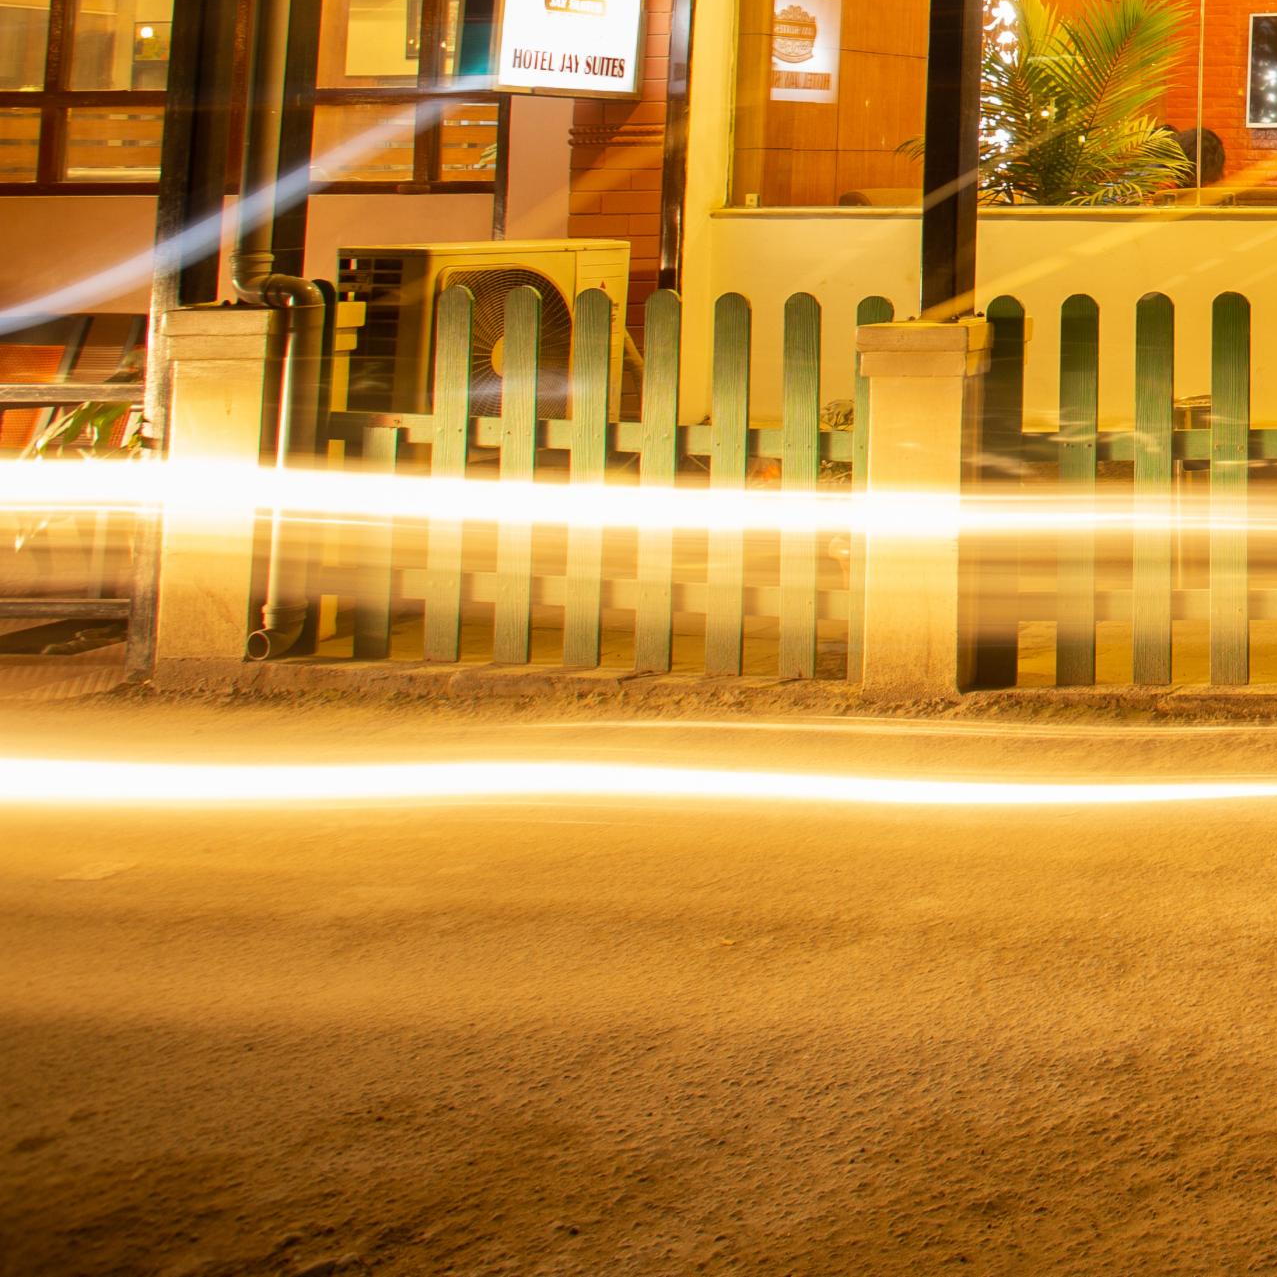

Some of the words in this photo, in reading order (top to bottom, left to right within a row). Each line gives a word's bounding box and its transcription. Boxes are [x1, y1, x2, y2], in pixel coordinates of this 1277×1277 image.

[511, 48, 555, 73] HOTEL
[559, 51, 580, 74] JAY
[584, 56, 626, 78] SUITES
